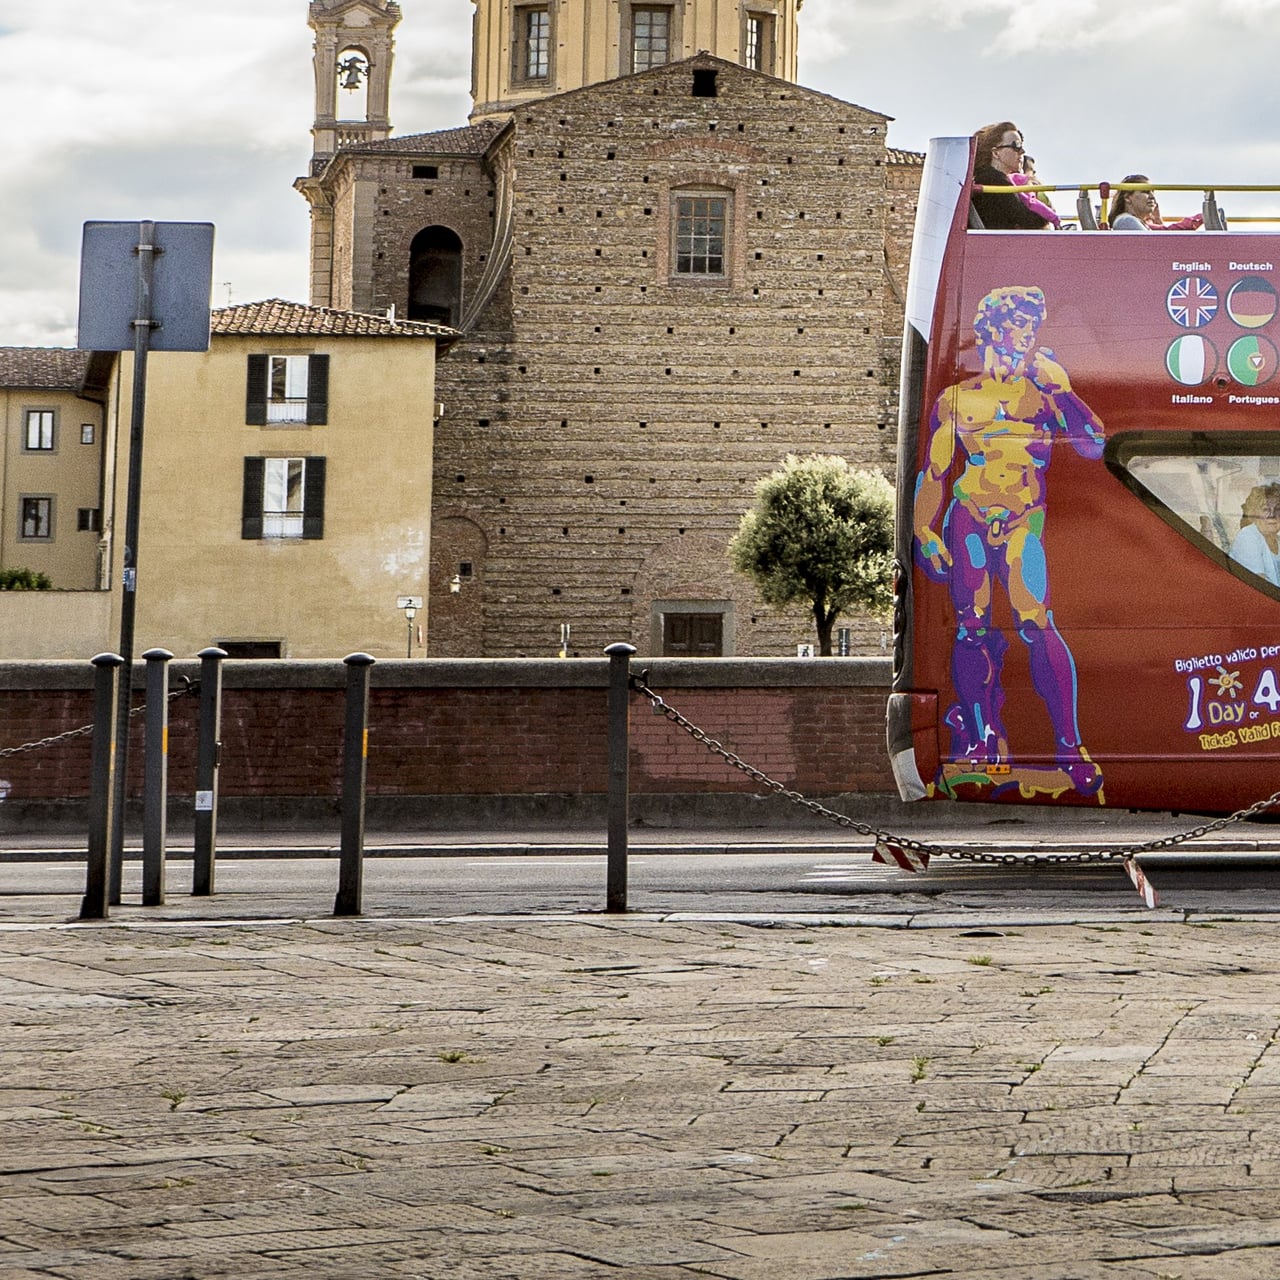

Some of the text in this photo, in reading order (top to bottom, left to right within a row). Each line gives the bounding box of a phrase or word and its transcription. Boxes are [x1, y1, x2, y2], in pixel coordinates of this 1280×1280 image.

[1171, 261, 1212, 272] English
[1228, 261, 1273, 271] Deutsch
[1171, 393, 1214, 404] Italiano
[1228, 394, 1280, 406] Portugues
[1174, 654, 1223, 673] Biglietto
[1225, 647, 1258, 664] valido
[1260, 645, 1280, 659] per
[1187, 677, 1202, 729] 1
[1208, 701, 1245, 724] Day
[1249, 711, 1260, 719] or
[1199, 730, 1239, 750] Ticket
[1238, 723, 1271, 743] Valid
